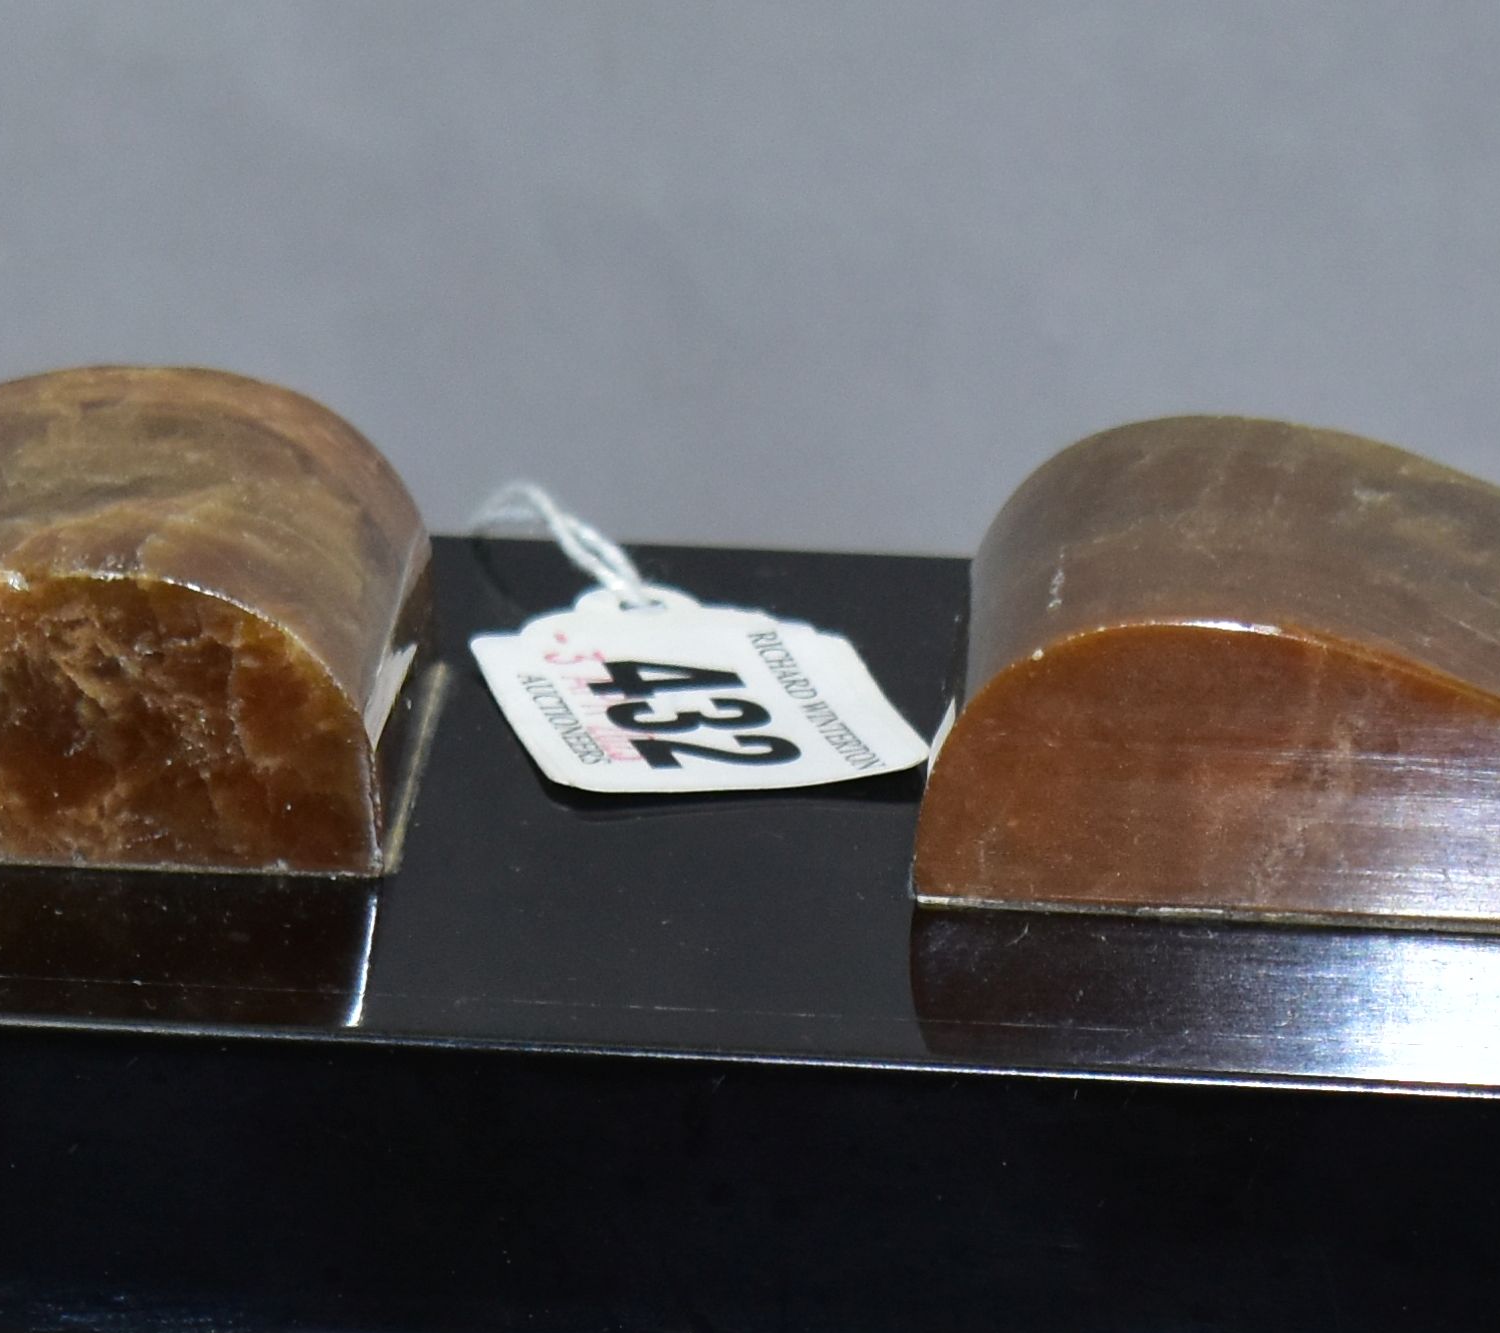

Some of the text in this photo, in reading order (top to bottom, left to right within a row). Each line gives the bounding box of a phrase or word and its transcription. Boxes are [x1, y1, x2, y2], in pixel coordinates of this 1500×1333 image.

[517, 675, 611, 764] AUCTIONEERS
[586, 660, 802, 769] 432
[747, 630, 886, 770] RICHARD WINTERTON
